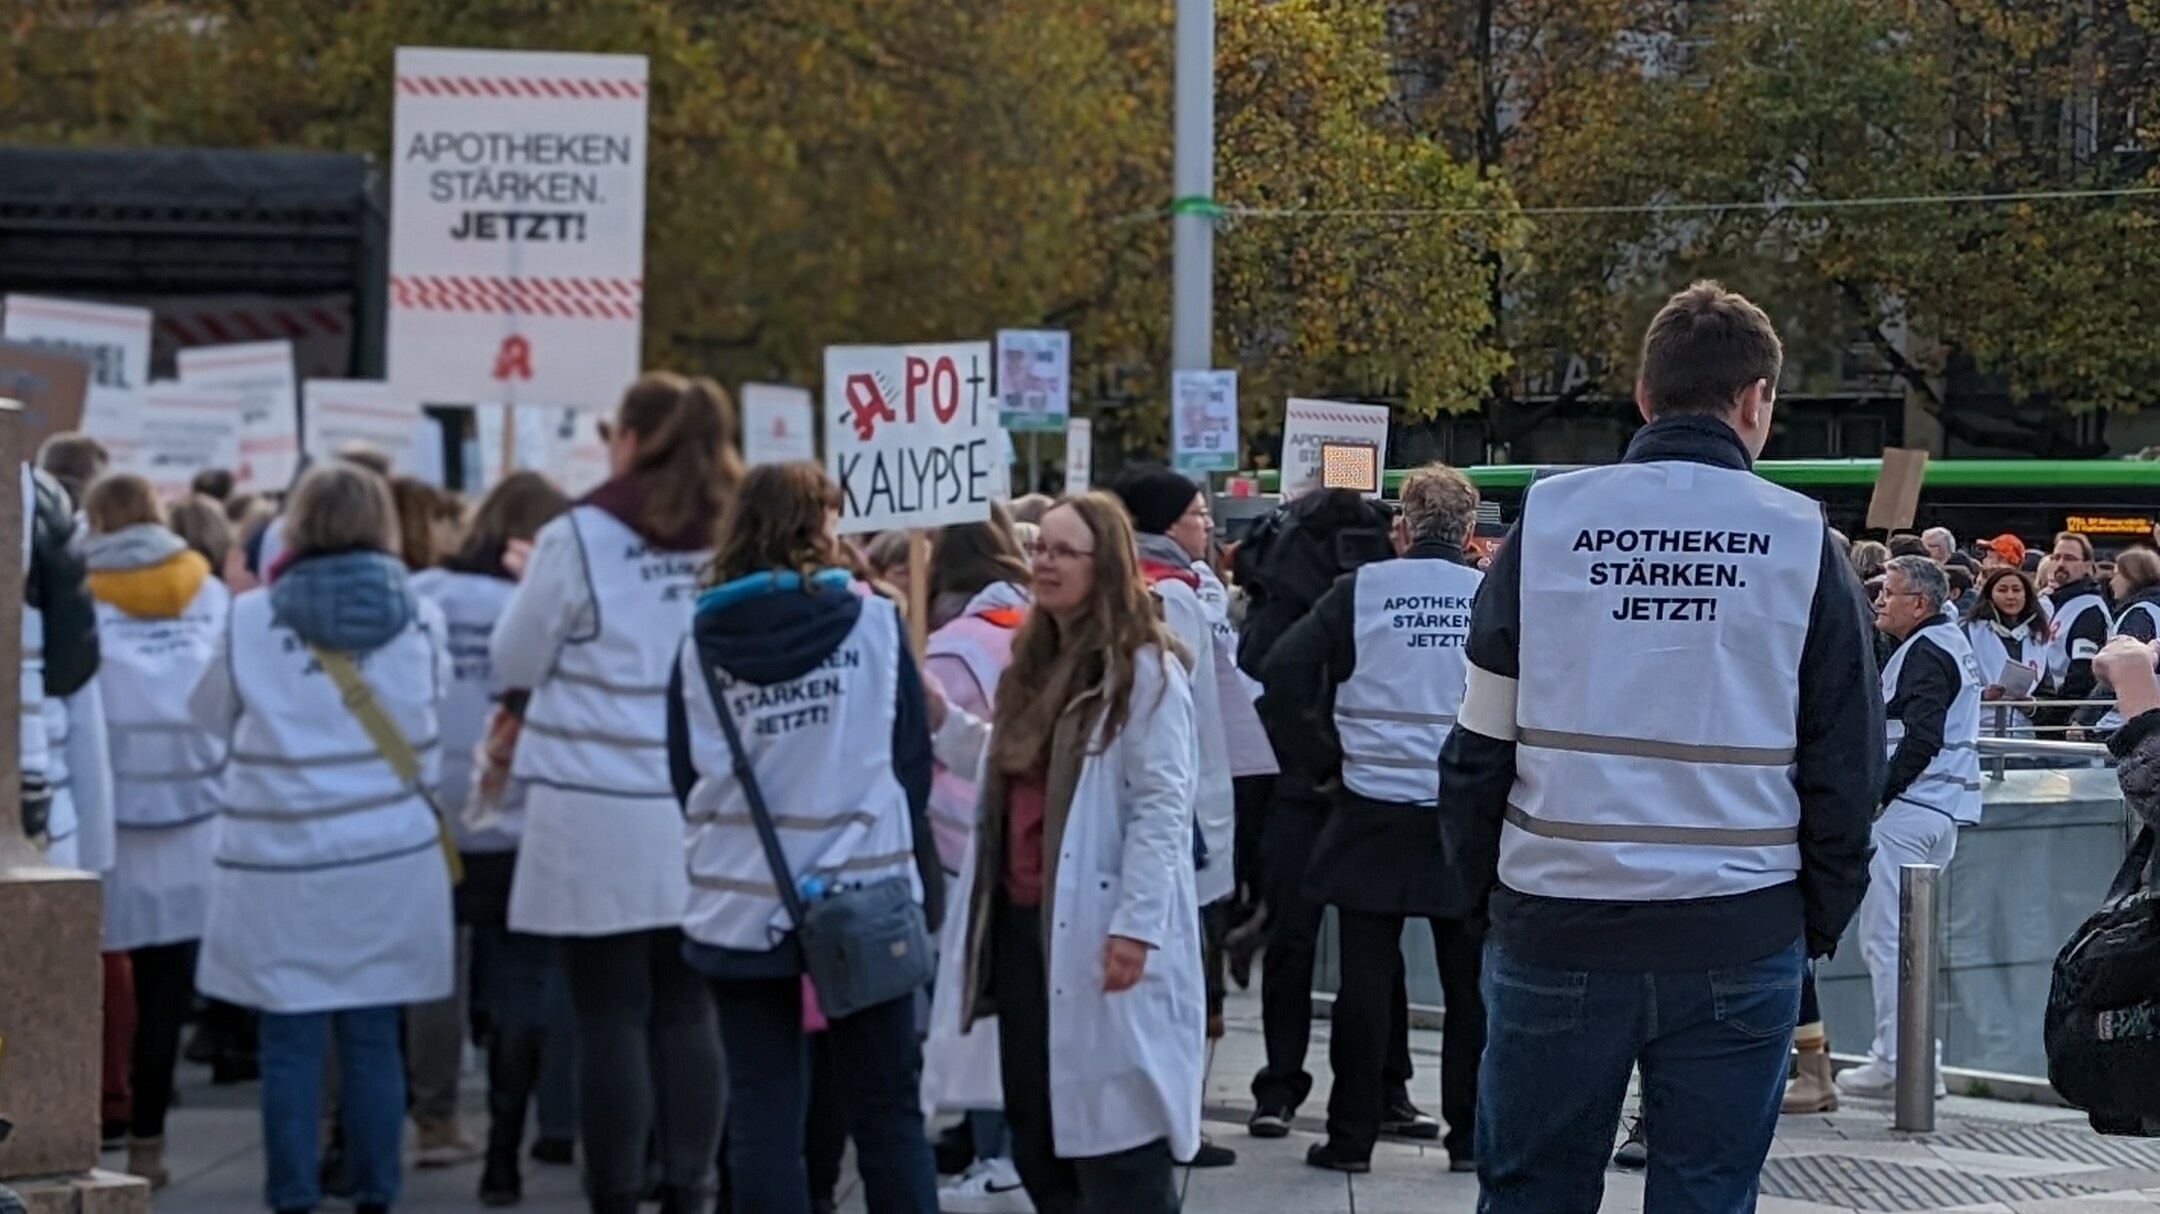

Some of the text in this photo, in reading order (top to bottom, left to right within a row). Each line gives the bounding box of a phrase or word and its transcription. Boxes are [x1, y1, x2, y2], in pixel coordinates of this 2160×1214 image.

[406, 131, 631, 165] APOTHEKEN
[429, 166, 606, 204] STÄRKEN.
[450, 211, 587, 241] JETZT!
[838, 438, 988, 518] KALYPSE
[1572, 529, 1771, 555] APOTHEKEN
[1589, 556, 1747, 588] STÄRKEN.
[1612, 597, 1717, 621] JETZT!
[1407, 633, 1466, 647] JETZT!
